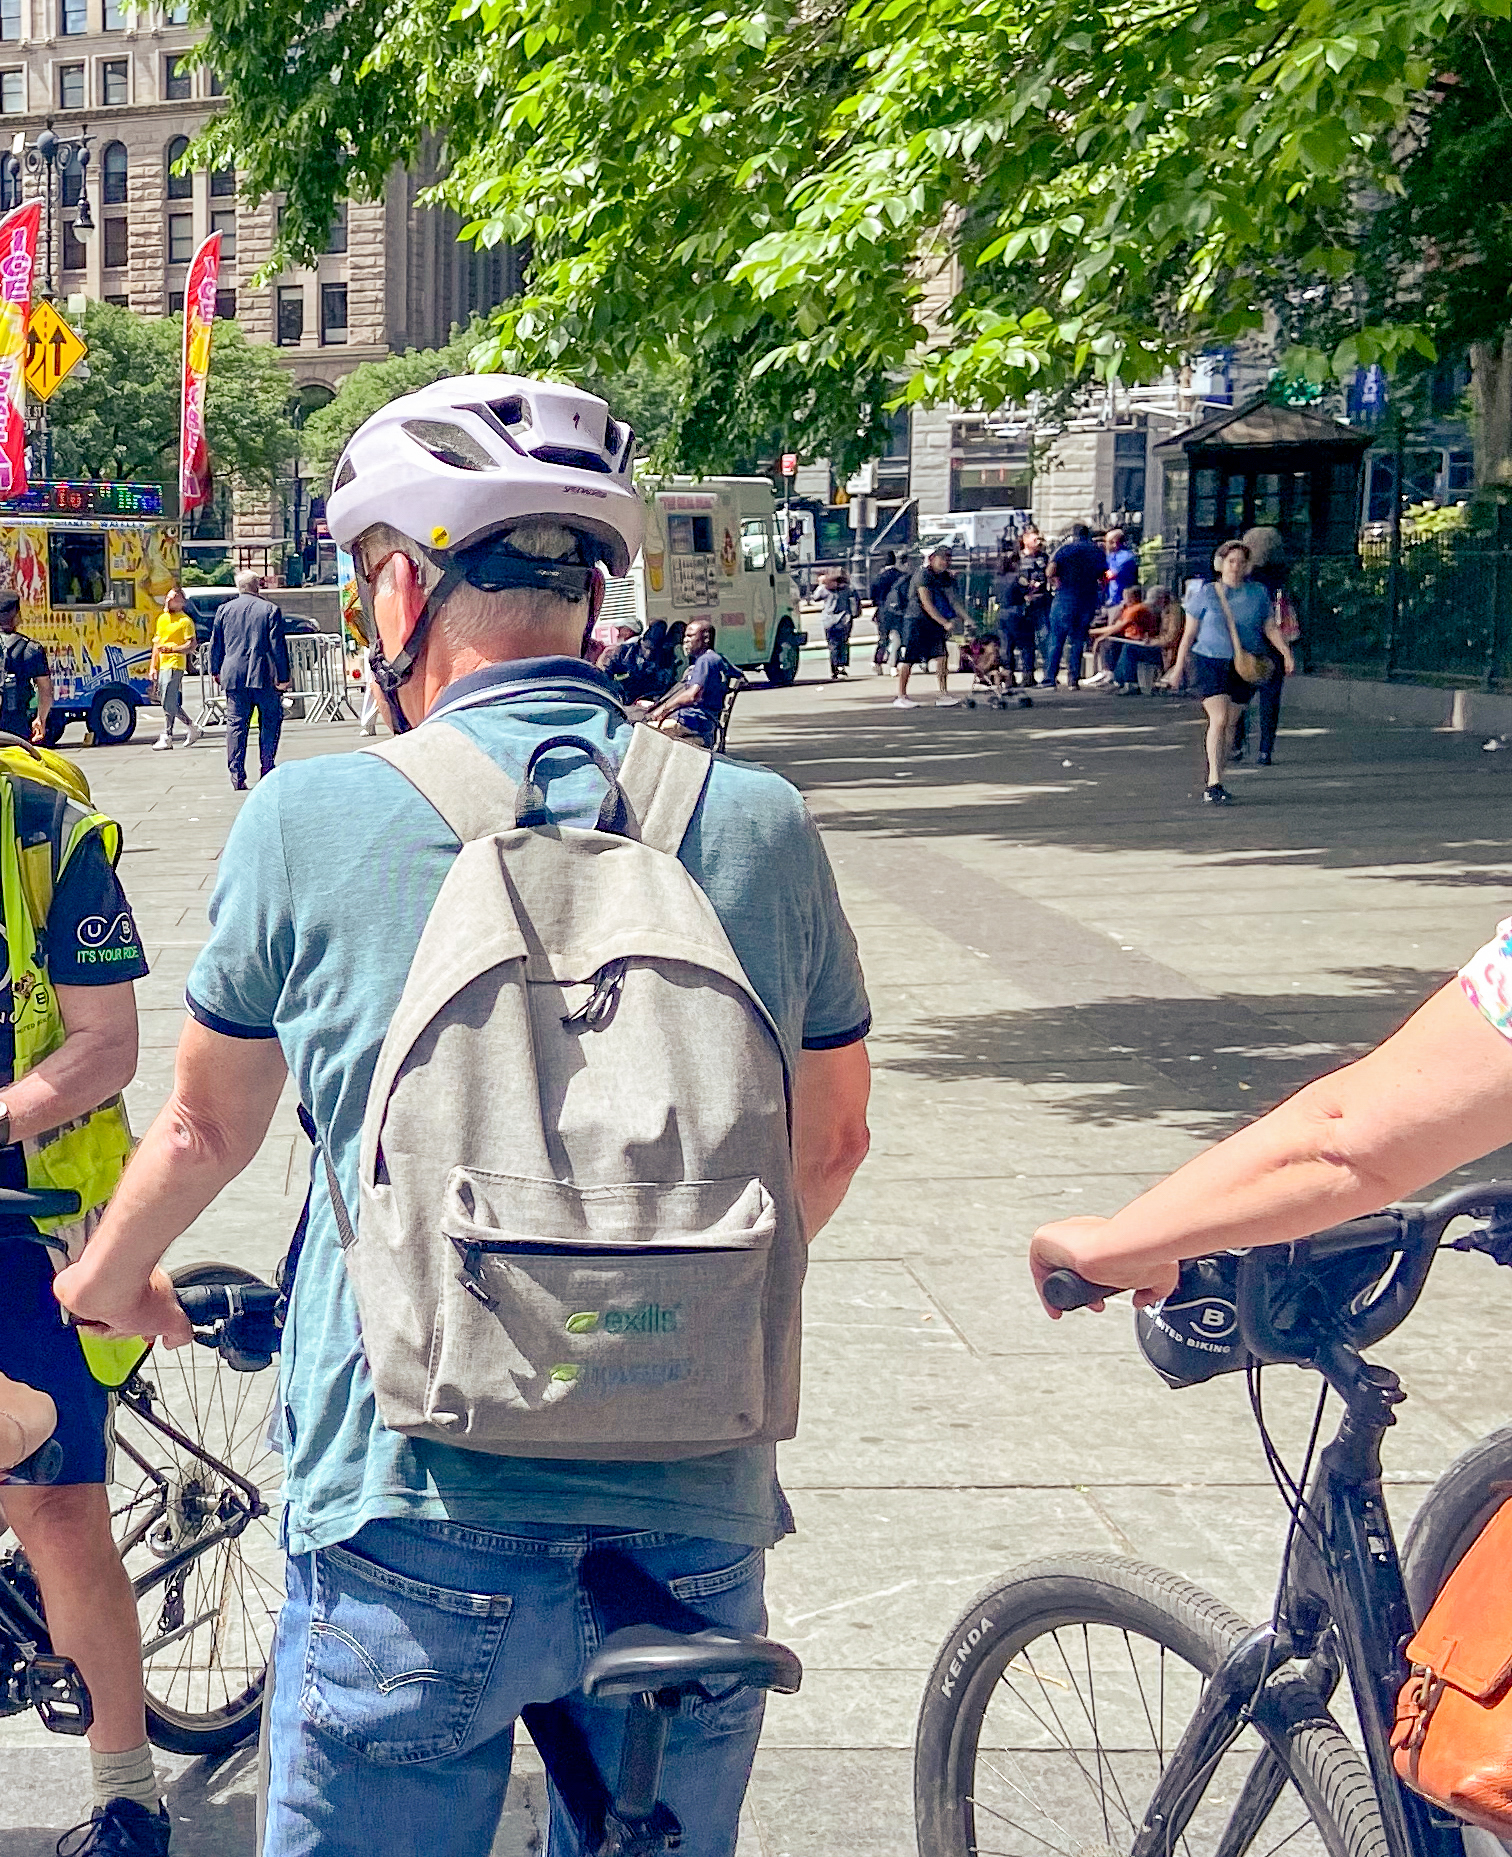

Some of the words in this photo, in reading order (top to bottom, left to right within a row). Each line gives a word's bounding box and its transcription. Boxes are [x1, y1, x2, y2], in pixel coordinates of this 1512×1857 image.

[0, 227, 33, 303] ICE
[197, 256, 217, 326] ICE
[98, 947, 122, 963] YOUR
[1201, 1307, 1225, 1327] B
[1186, 1337, 1231, 1354] BIKING
[940, 1617, 994, 1698] KENDA
